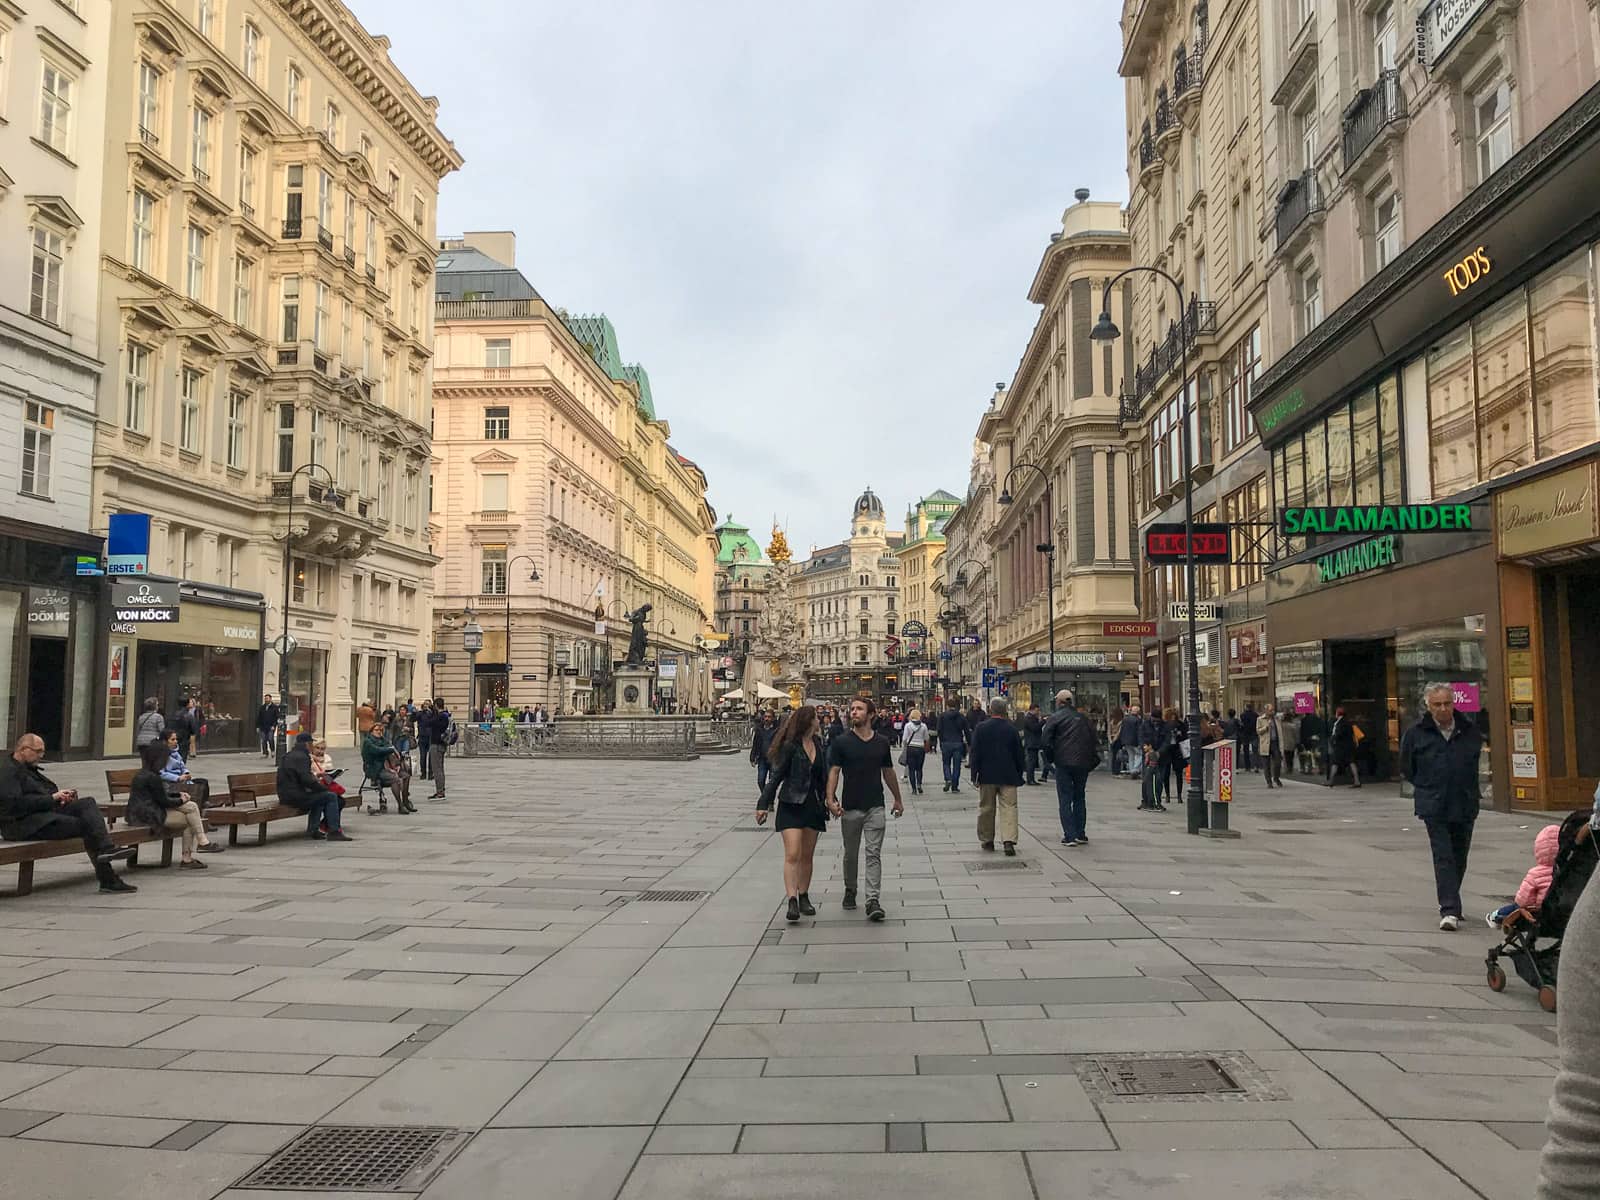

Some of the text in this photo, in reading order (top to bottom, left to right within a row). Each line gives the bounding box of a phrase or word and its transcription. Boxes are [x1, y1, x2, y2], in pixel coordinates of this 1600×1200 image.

[1436, 0, 1461, 26] PEN
[1444, 246, 1490, 296] TOD'S
[1284, 505, 1472, 534] SALAMANDER
[1316, 534, 1397, 584] SALAMANDER
[109, 564, 135, 573] ERSTE
[127, 595, 162, 604] OMEGA
[116, 608, 170, 620] VON KÖCK
[111, 623, 137, 634] OMEGA
[1109, 624, 1151, 633] EDUSCHO
